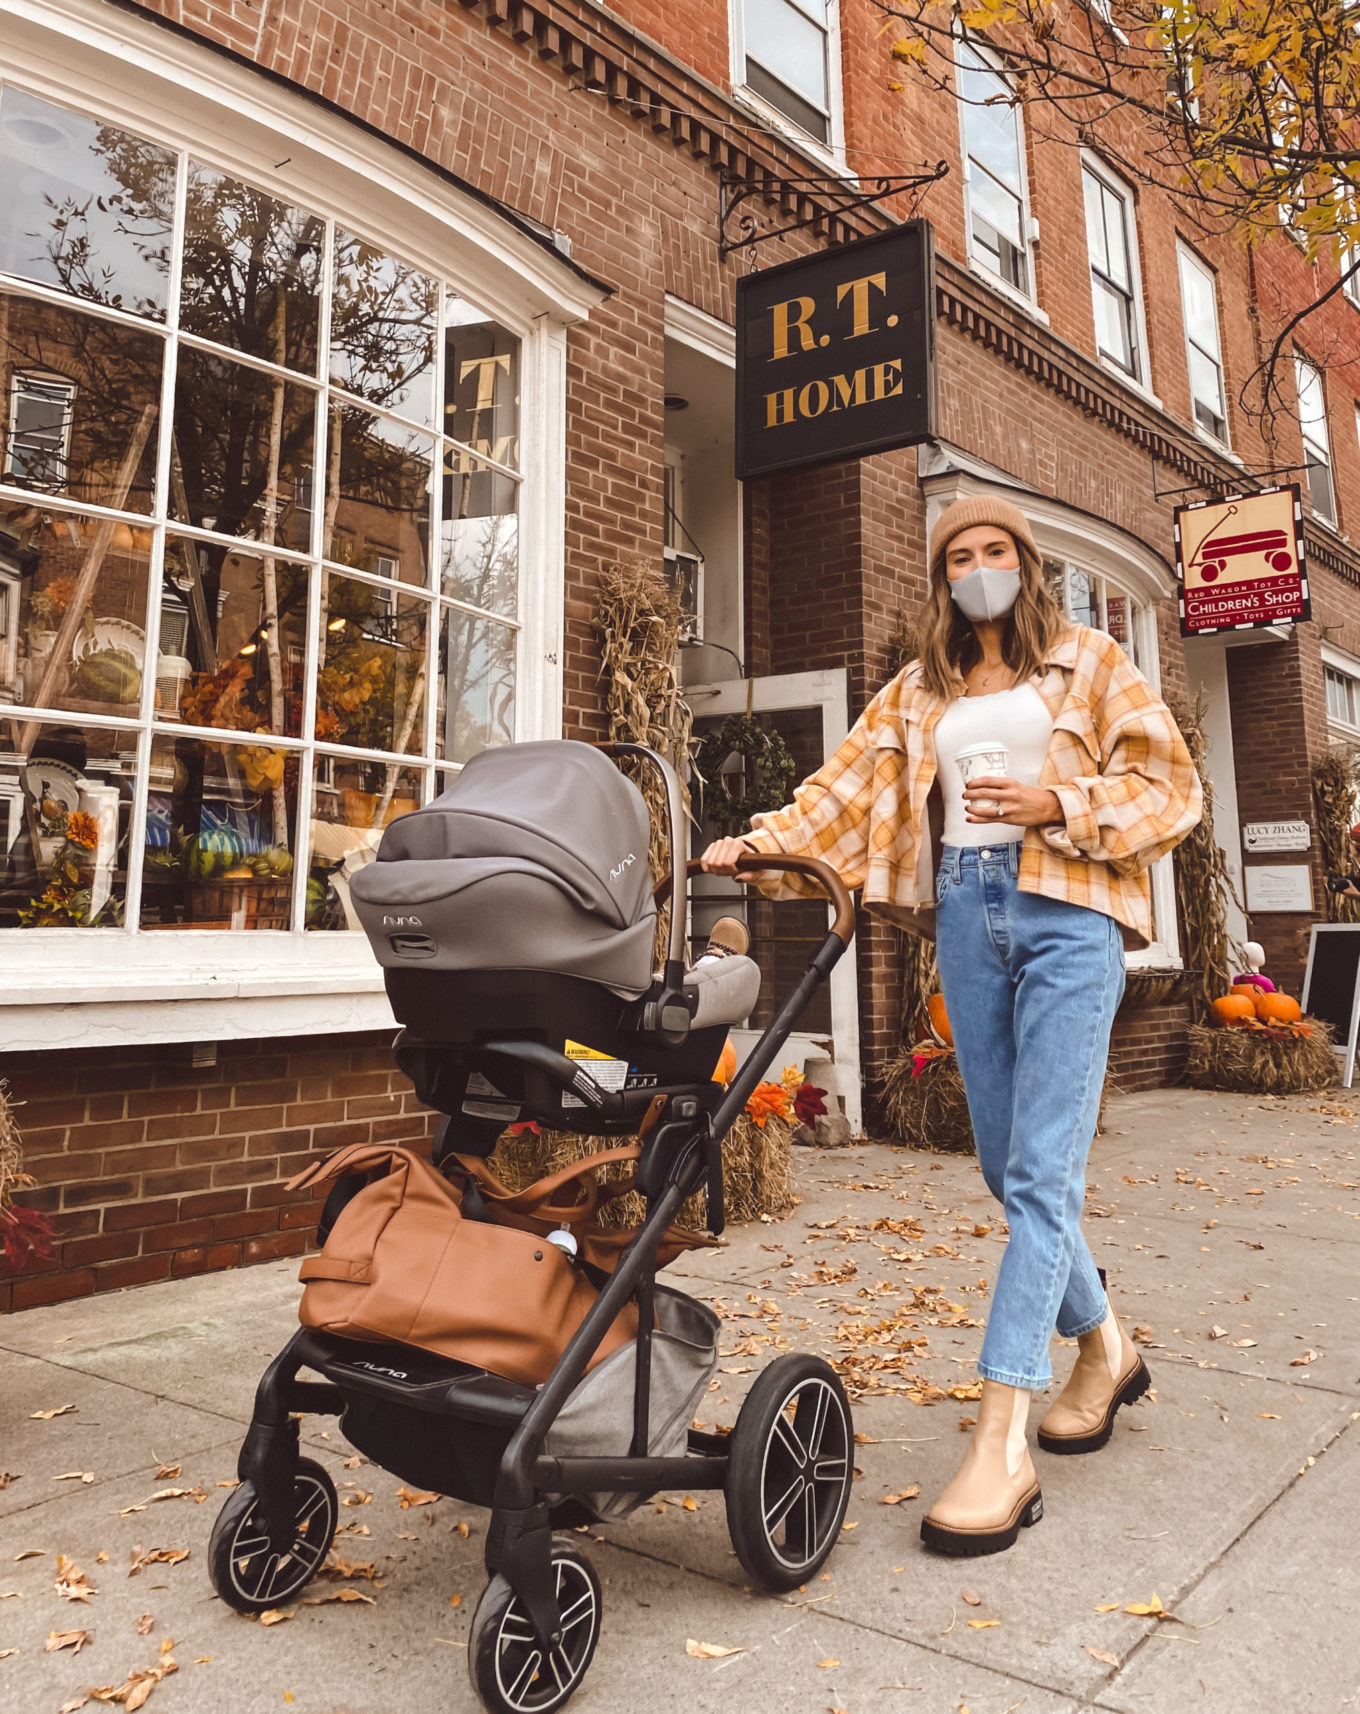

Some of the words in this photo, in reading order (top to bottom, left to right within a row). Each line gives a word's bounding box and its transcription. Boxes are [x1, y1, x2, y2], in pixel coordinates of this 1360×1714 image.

[763, 358, 903, 428] HOME
[1211, 585, 1247, 595] WAGON
[1187, 595, 1260, 615] CHILDREN'S
[1264, 591, 1301, 605] SHOP
[1188, 617, 1231, 627] CLOTHING
[1243, 611, 1265, 620] TOYS
[1276, 607, 1302, 616] GIFTS
[1247, 826, 1269, 835] LUCY
[1272, 825, 1305, 834] ZHANG
